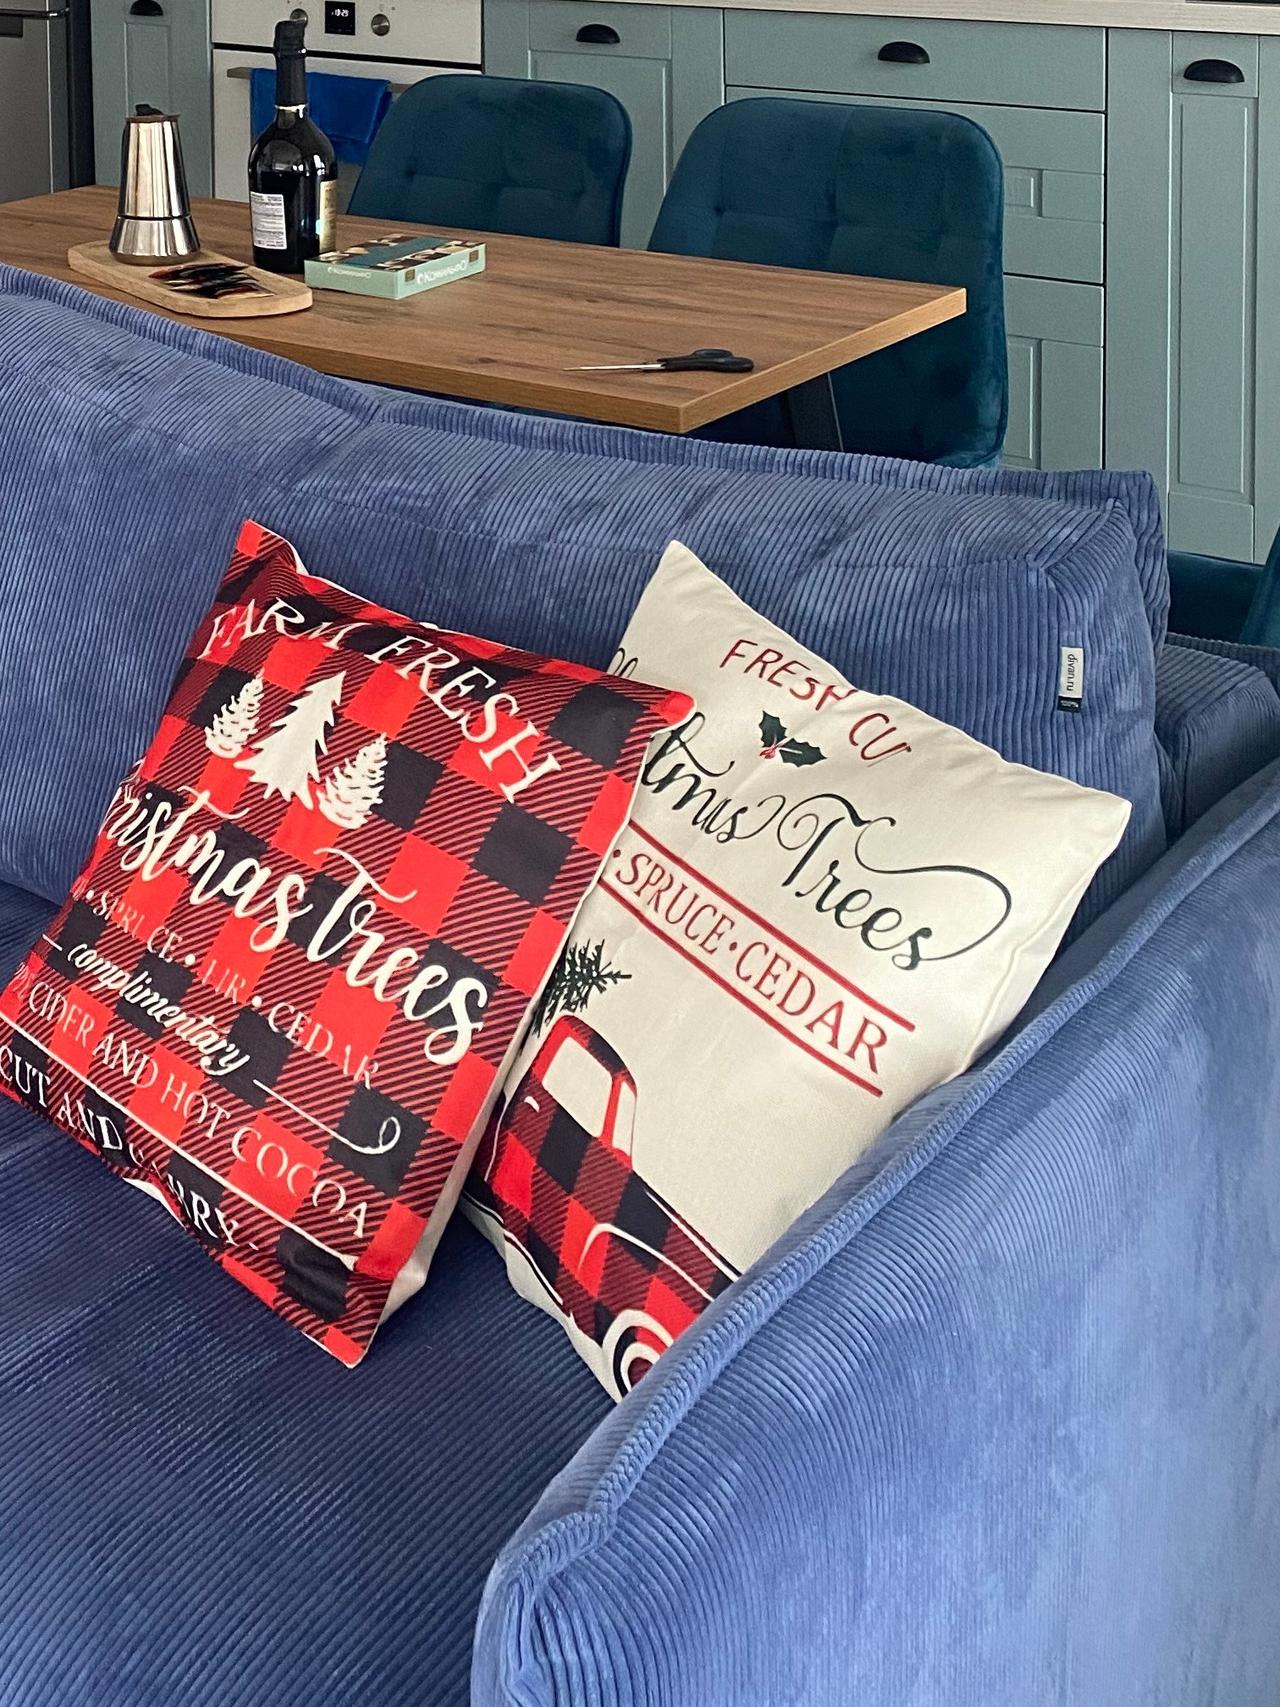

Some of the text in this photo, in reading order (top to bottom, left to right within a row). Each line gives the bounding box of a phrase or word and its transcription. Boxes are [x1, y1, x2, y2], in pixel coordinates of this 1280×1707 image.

[197, 597, 562, 804] FARM FRESH
[719, 638, 912, 768] FRESH CU
[1066, 653, 1079, 692] divan.ru
[306, 846, 488, 1066] Trees
[776, 793, 1011, 971] Trees
[67, 942, 251, 1077] complimentary
[28, 981, 369, 1239] CIDER AND HOT COCOA
[56, 1092, 124, 1151] AND
